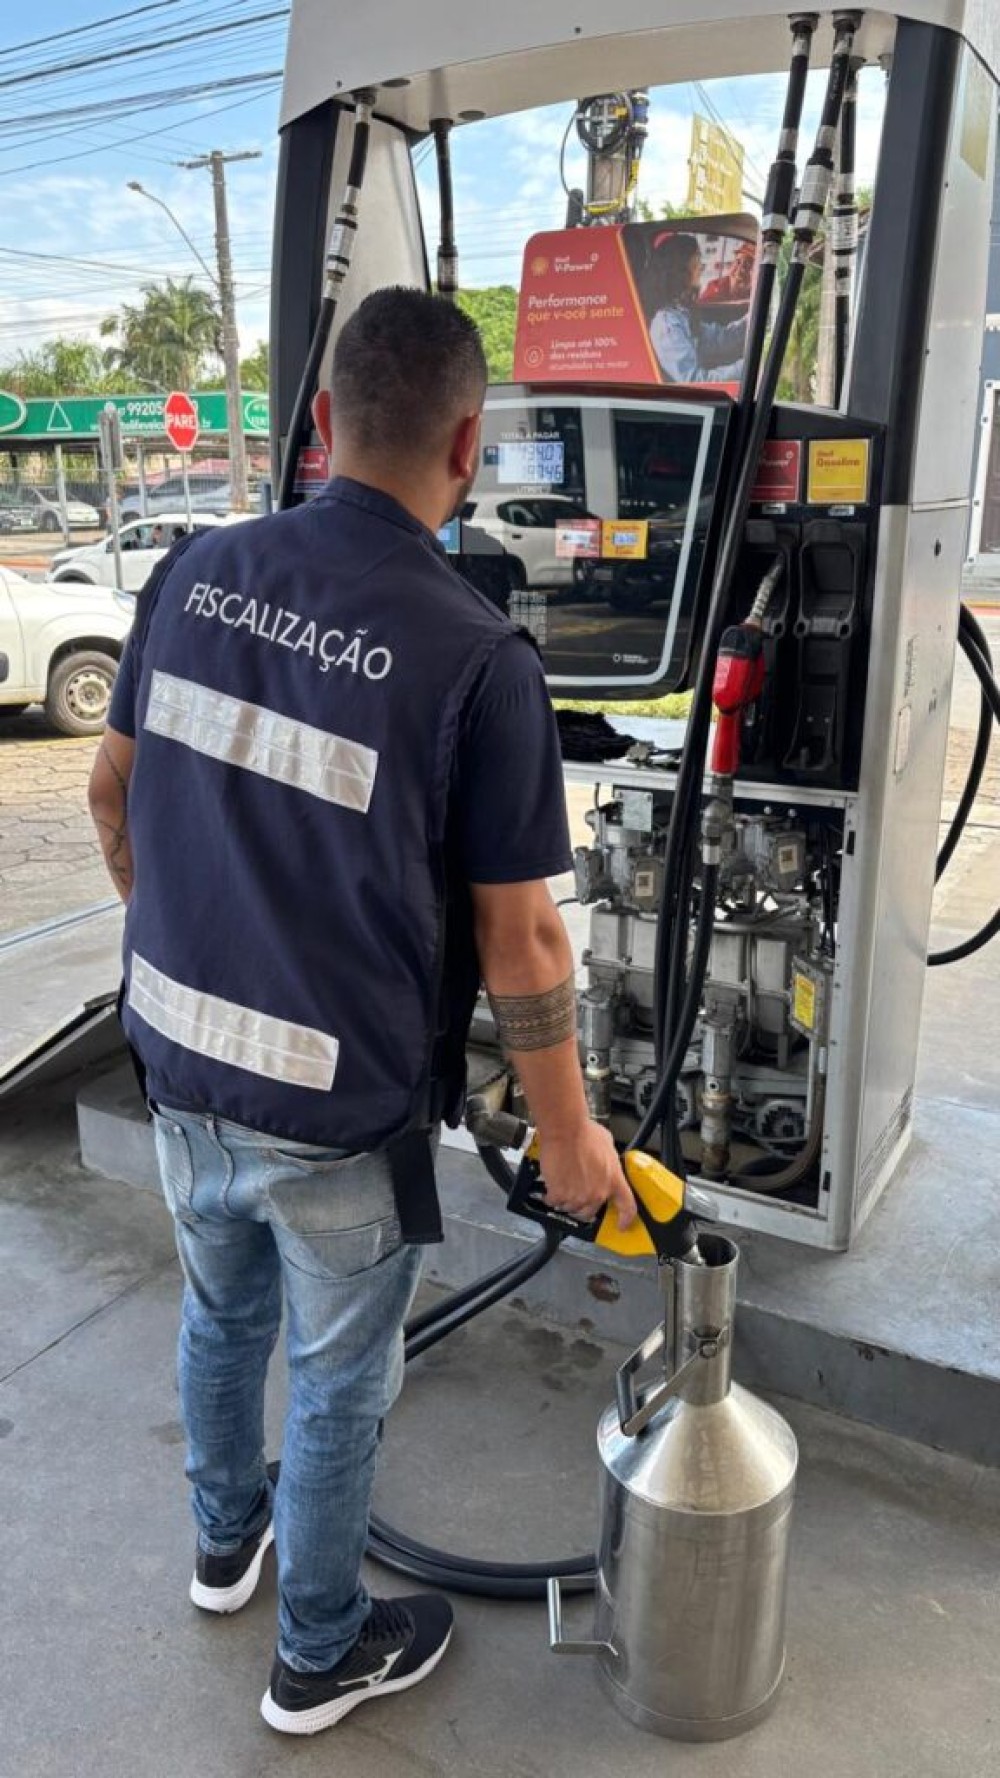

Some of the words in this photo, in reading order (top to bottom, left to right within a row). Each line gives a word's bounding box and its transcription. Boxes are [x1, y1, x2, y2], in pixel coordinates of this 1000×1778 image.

[555, 262, 595, 273] V-Power
[528, 293, 608, 309] Performance
[527, 311, 551, 325] que
[589, 306, 625, 318] sente
[167, 414, 196, 428] PARE
[184, 583, 393, 680] FISCALIZAÇÃO
